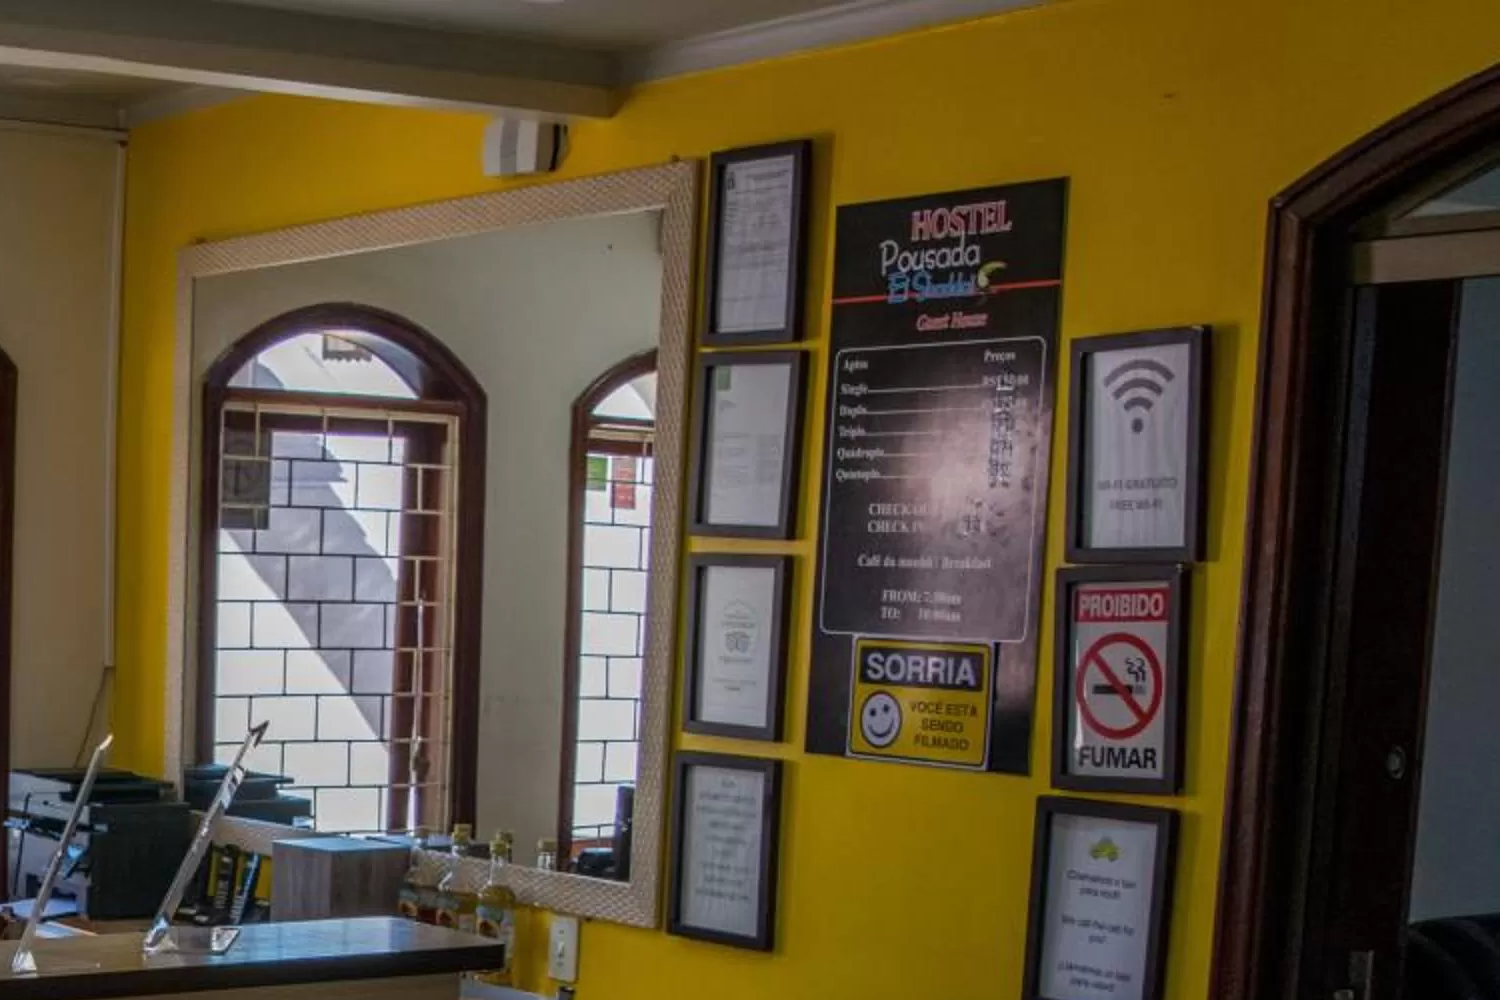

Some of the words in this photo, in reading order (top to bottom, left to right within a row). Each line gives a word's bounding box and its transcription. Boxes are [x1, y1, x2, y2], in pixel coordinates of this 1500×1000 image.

[911, 200, 1013, 241] HOSTEL
[879, 230, 981, 277] Pousada
[868, 503, 909, 516] CHECK
[867, 519, 910, 533] CHECK
[1079, 593, 1165, 617] PROIBIDO
[866, 652, 977, 687] SORRIA
[921, 719, 965, 733] SENDO
[913, 734, 972, 751] FILMADO
[1078, 745, 1157, 769] FUMAR
